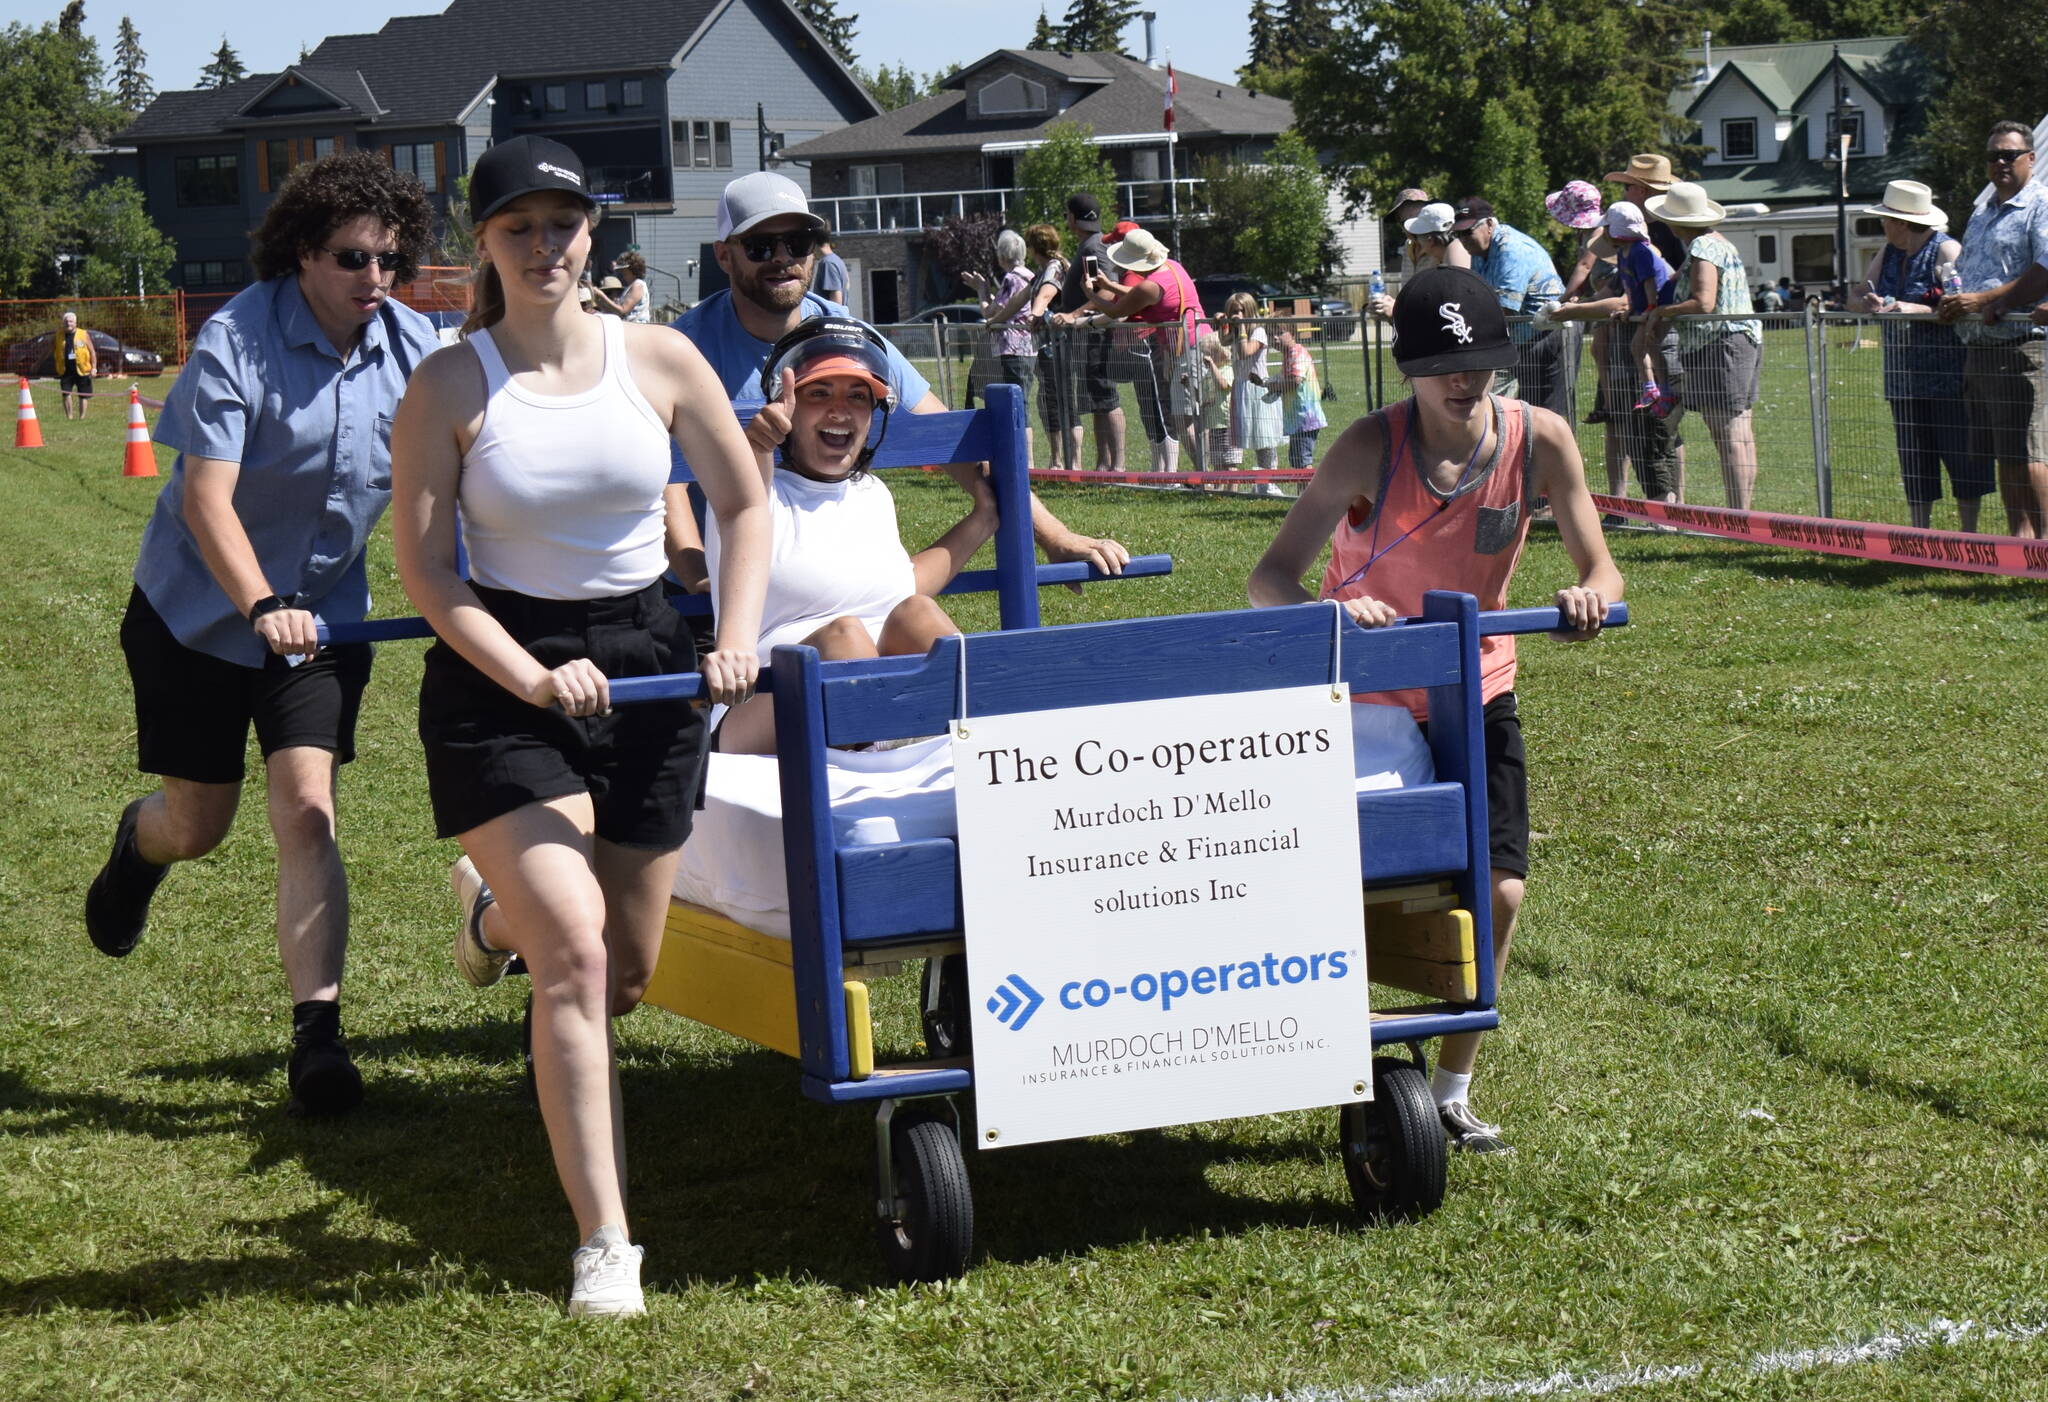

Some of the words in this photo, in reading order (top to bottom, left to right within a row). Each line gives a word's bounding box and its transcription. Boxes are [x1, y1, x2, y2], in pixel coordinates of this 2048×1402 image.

[1707, 510, 1723, 530] NOT
[1724, 512, 1750, 534] ENTER
[1769, 518, 1803, 542] DANGER
[1803, 522, 1817, 544] DO
[1817, 523, 1835, 547] NOT
[1837, 525, 1866, 551] ENTER
[1888, 531, 1927, 559] DANGER
[1927, 535, 1943, 560] DO
[1943, 537, 1964, 563] NOT
[1965, 540, 1998, 567] ENTER
[978, 747, 1058, 786] The
[1075, 728, 1331, 776] Co-operators
[1053, 799, 1165, 831] Murdoch
[1173, 789, 1272, 819] D'Mello
[1027, 851, 1149, 878] Insurance
[1159, 841, 1179, 864] &
[1187, 827, 1300, 861] Financial
[1094, 886, 1201, 914] solutions
[1209, 880, 1248, 902] Inc
[1059, 950, 1349, 1011] co-operators
[1022, 1064, 1109, 1085] INSURANCE
[1113, 1062, 1122, 1074] &
[1127, 1052, 1207, 1072] FINANCIAL
[1211, 1042, 1296, 1062] SOLUTIONS
[1300, 1038, 1331, 1051] INC.
[1053, 1030, 1183, 1067] MURDOCH
[1193, 1016, 1299, 1050] D'MELLO
